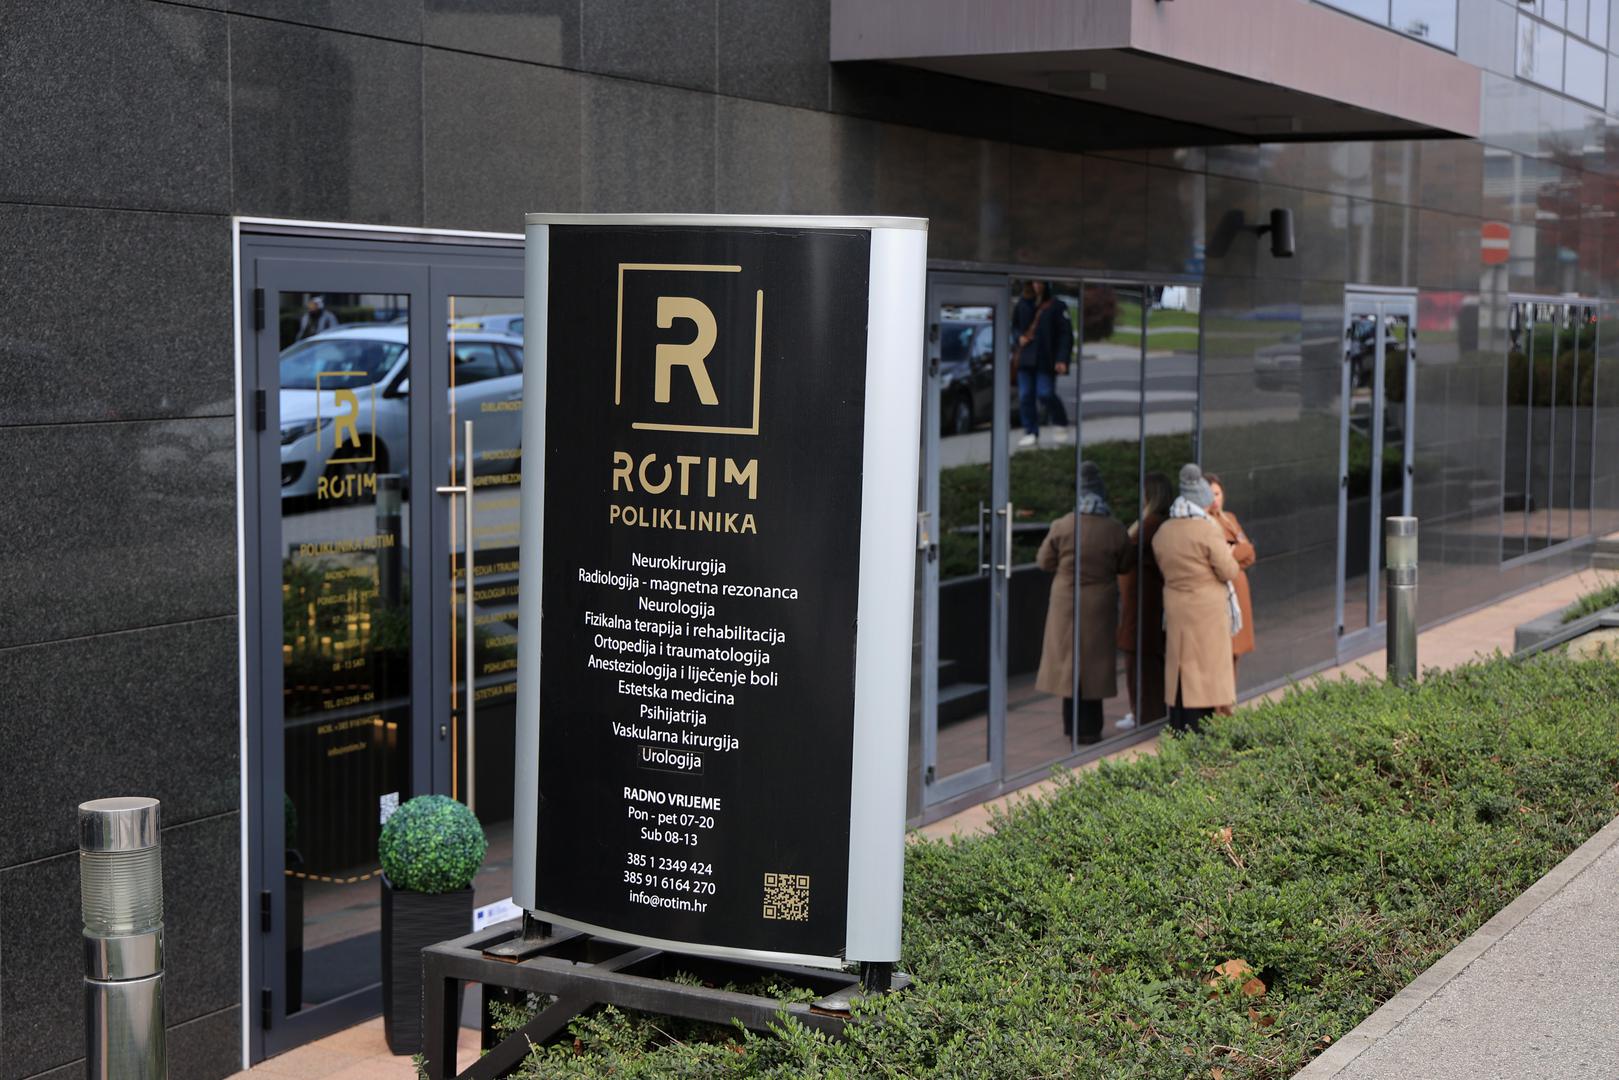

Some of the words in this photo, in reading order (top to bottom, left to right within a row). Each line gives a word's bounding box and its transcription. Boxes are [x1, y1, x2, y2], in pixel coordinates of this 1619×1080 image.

[655, 296, 719, 405] R
[335, 389, 361, 448] R
[318, 473, 376, 500] ROTIM
[612, 451, 758, 500] ROTIM
[609, 504, 757, 534] POLIKLINIKA
[632, 553, 726, 576] Neurokirurgija
[579, 568, 639, 590] Radiologija
[650, 579, 718, 595] magnetna
[723, 585, 798, 599] rezonanca
[639, 596, 714, 619] Neurologija
[585, 612, 631, 630] Fizikalna
[635, 619, 682, 638] terapija
[686, 623, 689, 636] i
[694, 624, 785, 645] rehabilitacija
[595, 634, 656, 657] Ortopedija
[660, 642, 662, 655] i
[666, 644, 769, 667] traumatologija
[588, 655, 676, 680] Anesteziologija
[681, 666, 684, 679] i
[688, 666, 746, 687] liječenje
[751, 670, 778, 686] boli
[619, 680, 667, 698] Estetska
[672, 688, 734, 705] medicina
[641, 704, 706, 727] Psihijatrija
[613, 722, 678, 743] Vaskularna
[682, 730, 738, 752] kirurgija
[643, 748, 701, 770] Urologija
[624, 787, 666, 804] RADNO
[668, 793, 720, 810] VRIJEME
[629, 806, 648, 820] Pon
[658, 814, 677, 825] pet
[680, 814, 714, 829] 07-20
[641, 827, 662, 841] Sub
[665, 831, 697, 846] 08-13
[627, 853, 646, 866] 385
[650, 857, 654, 868] 1
[659, 858, 687, 872] 2349
[690, 862, 712, 875] 424
[624, 871, 642, 884] 385
[645, 874, 657, 887] 91
[662, 877, 690, 891] 6164
[693, 881, 715, 894] 270
[630, 890, 707, 912] info@rotim.hr
